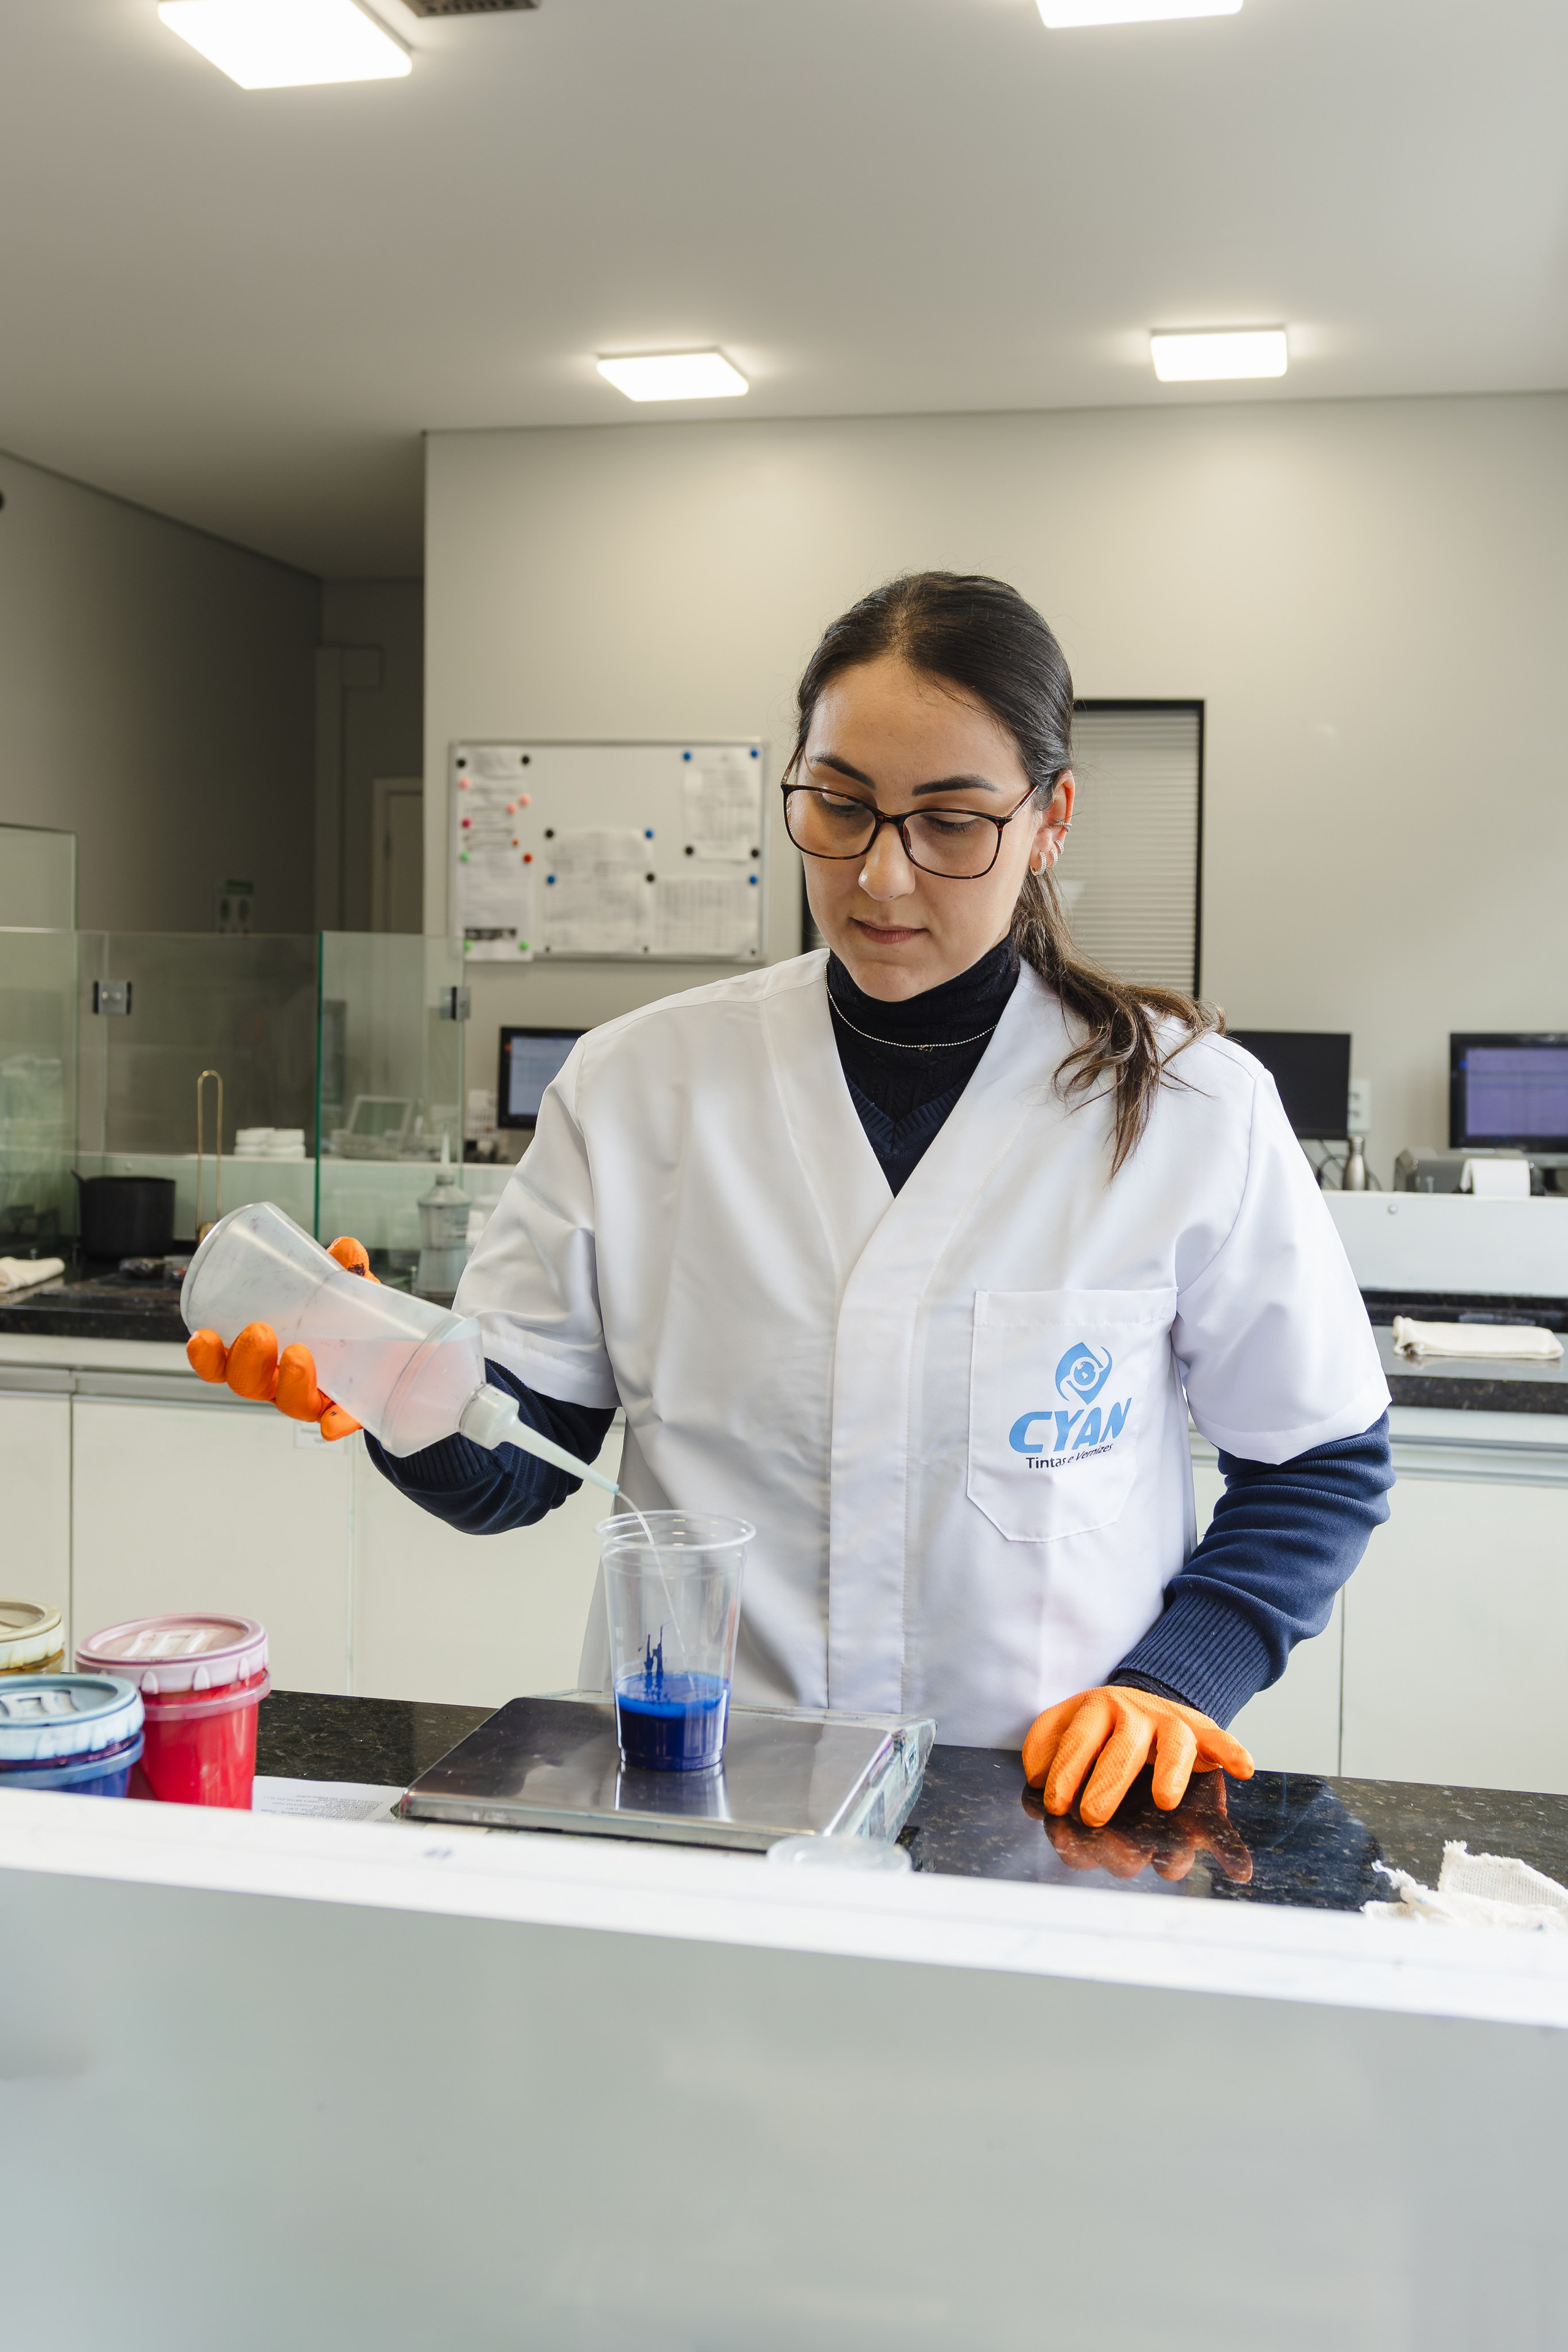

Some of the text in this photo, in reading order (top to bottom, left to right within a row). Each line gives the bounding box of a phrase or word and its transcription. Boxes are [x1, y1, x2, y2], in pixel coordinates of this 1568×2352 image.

[1009, 1397, 1133, 1453] CYAN
[1025, 1443, 1114, 1469] Tintas e Vernizes
